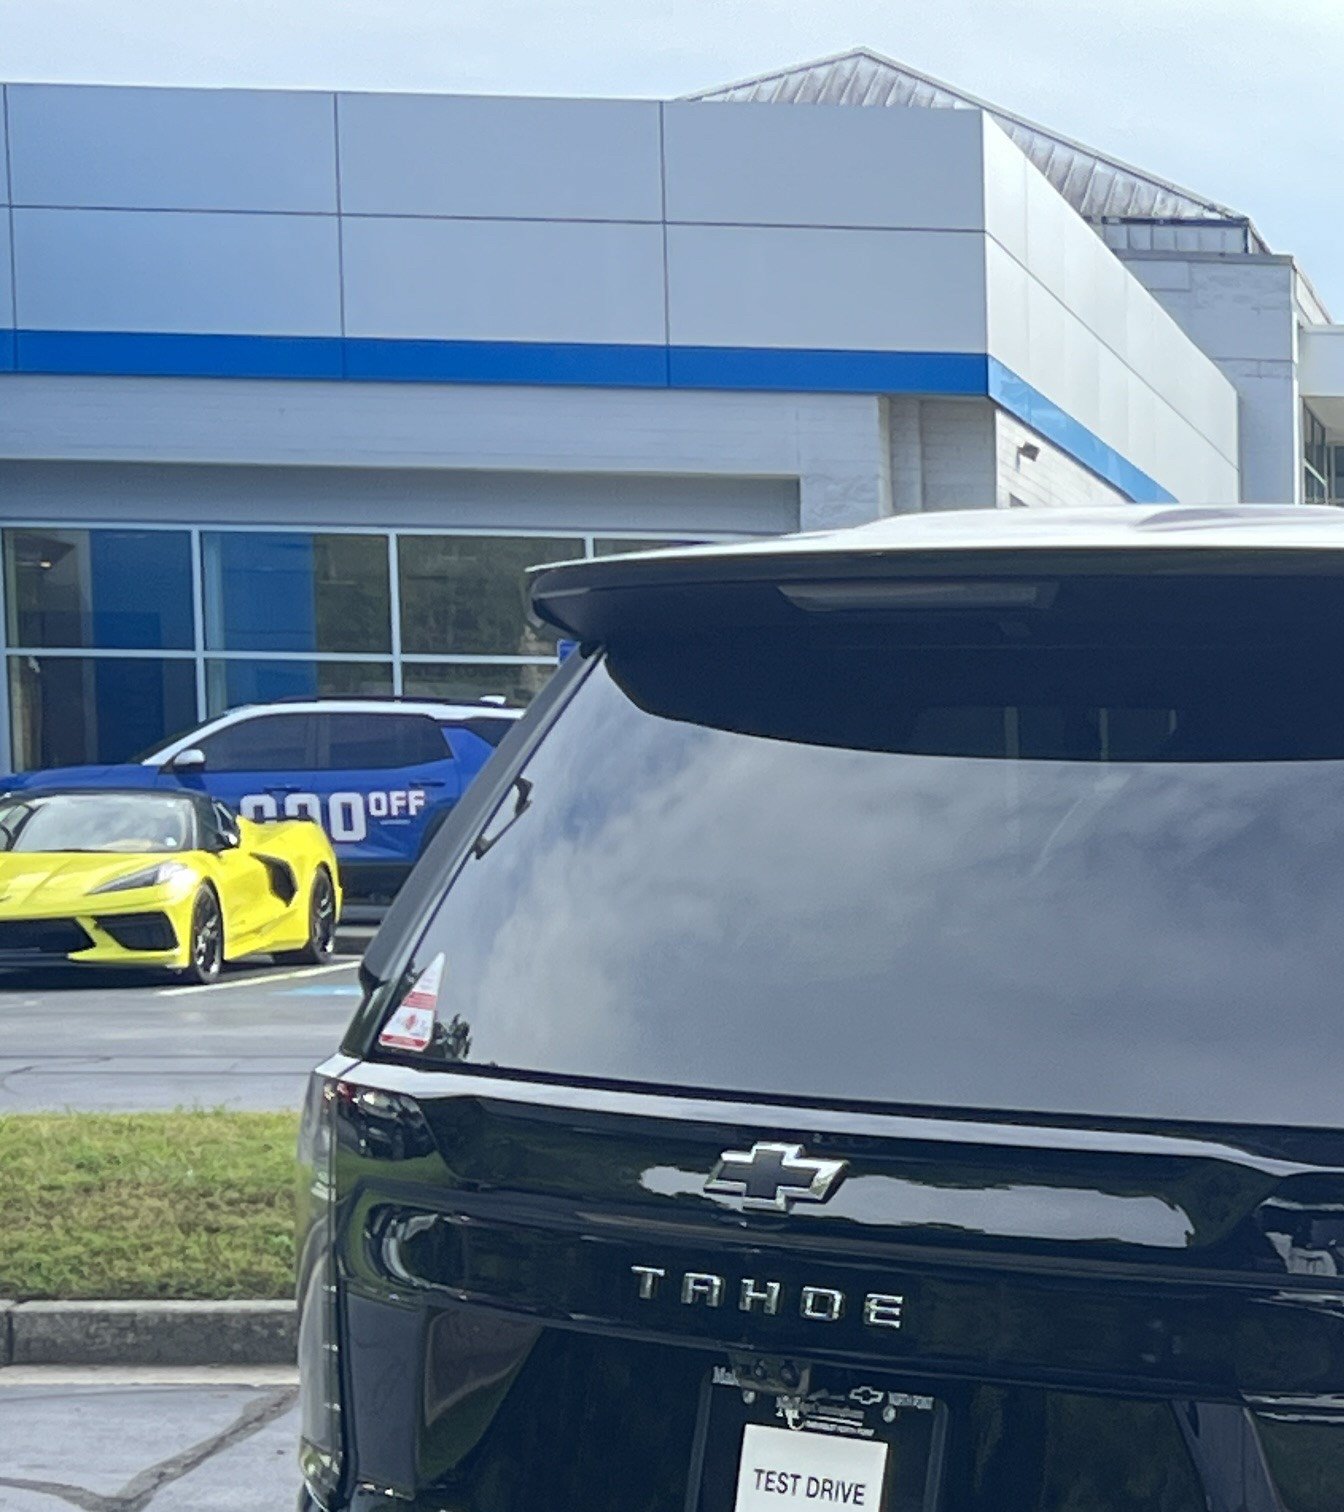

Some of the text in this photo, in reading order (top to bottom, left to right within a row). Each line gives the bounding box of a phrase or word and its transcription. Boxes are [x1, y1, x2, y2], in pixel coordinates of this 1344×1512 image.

[368, 790, 426, 817] OFF
[630, 1264, 904, 1330] TAHOE
[754, 1467, 866, 1506] TEST DRIVE
